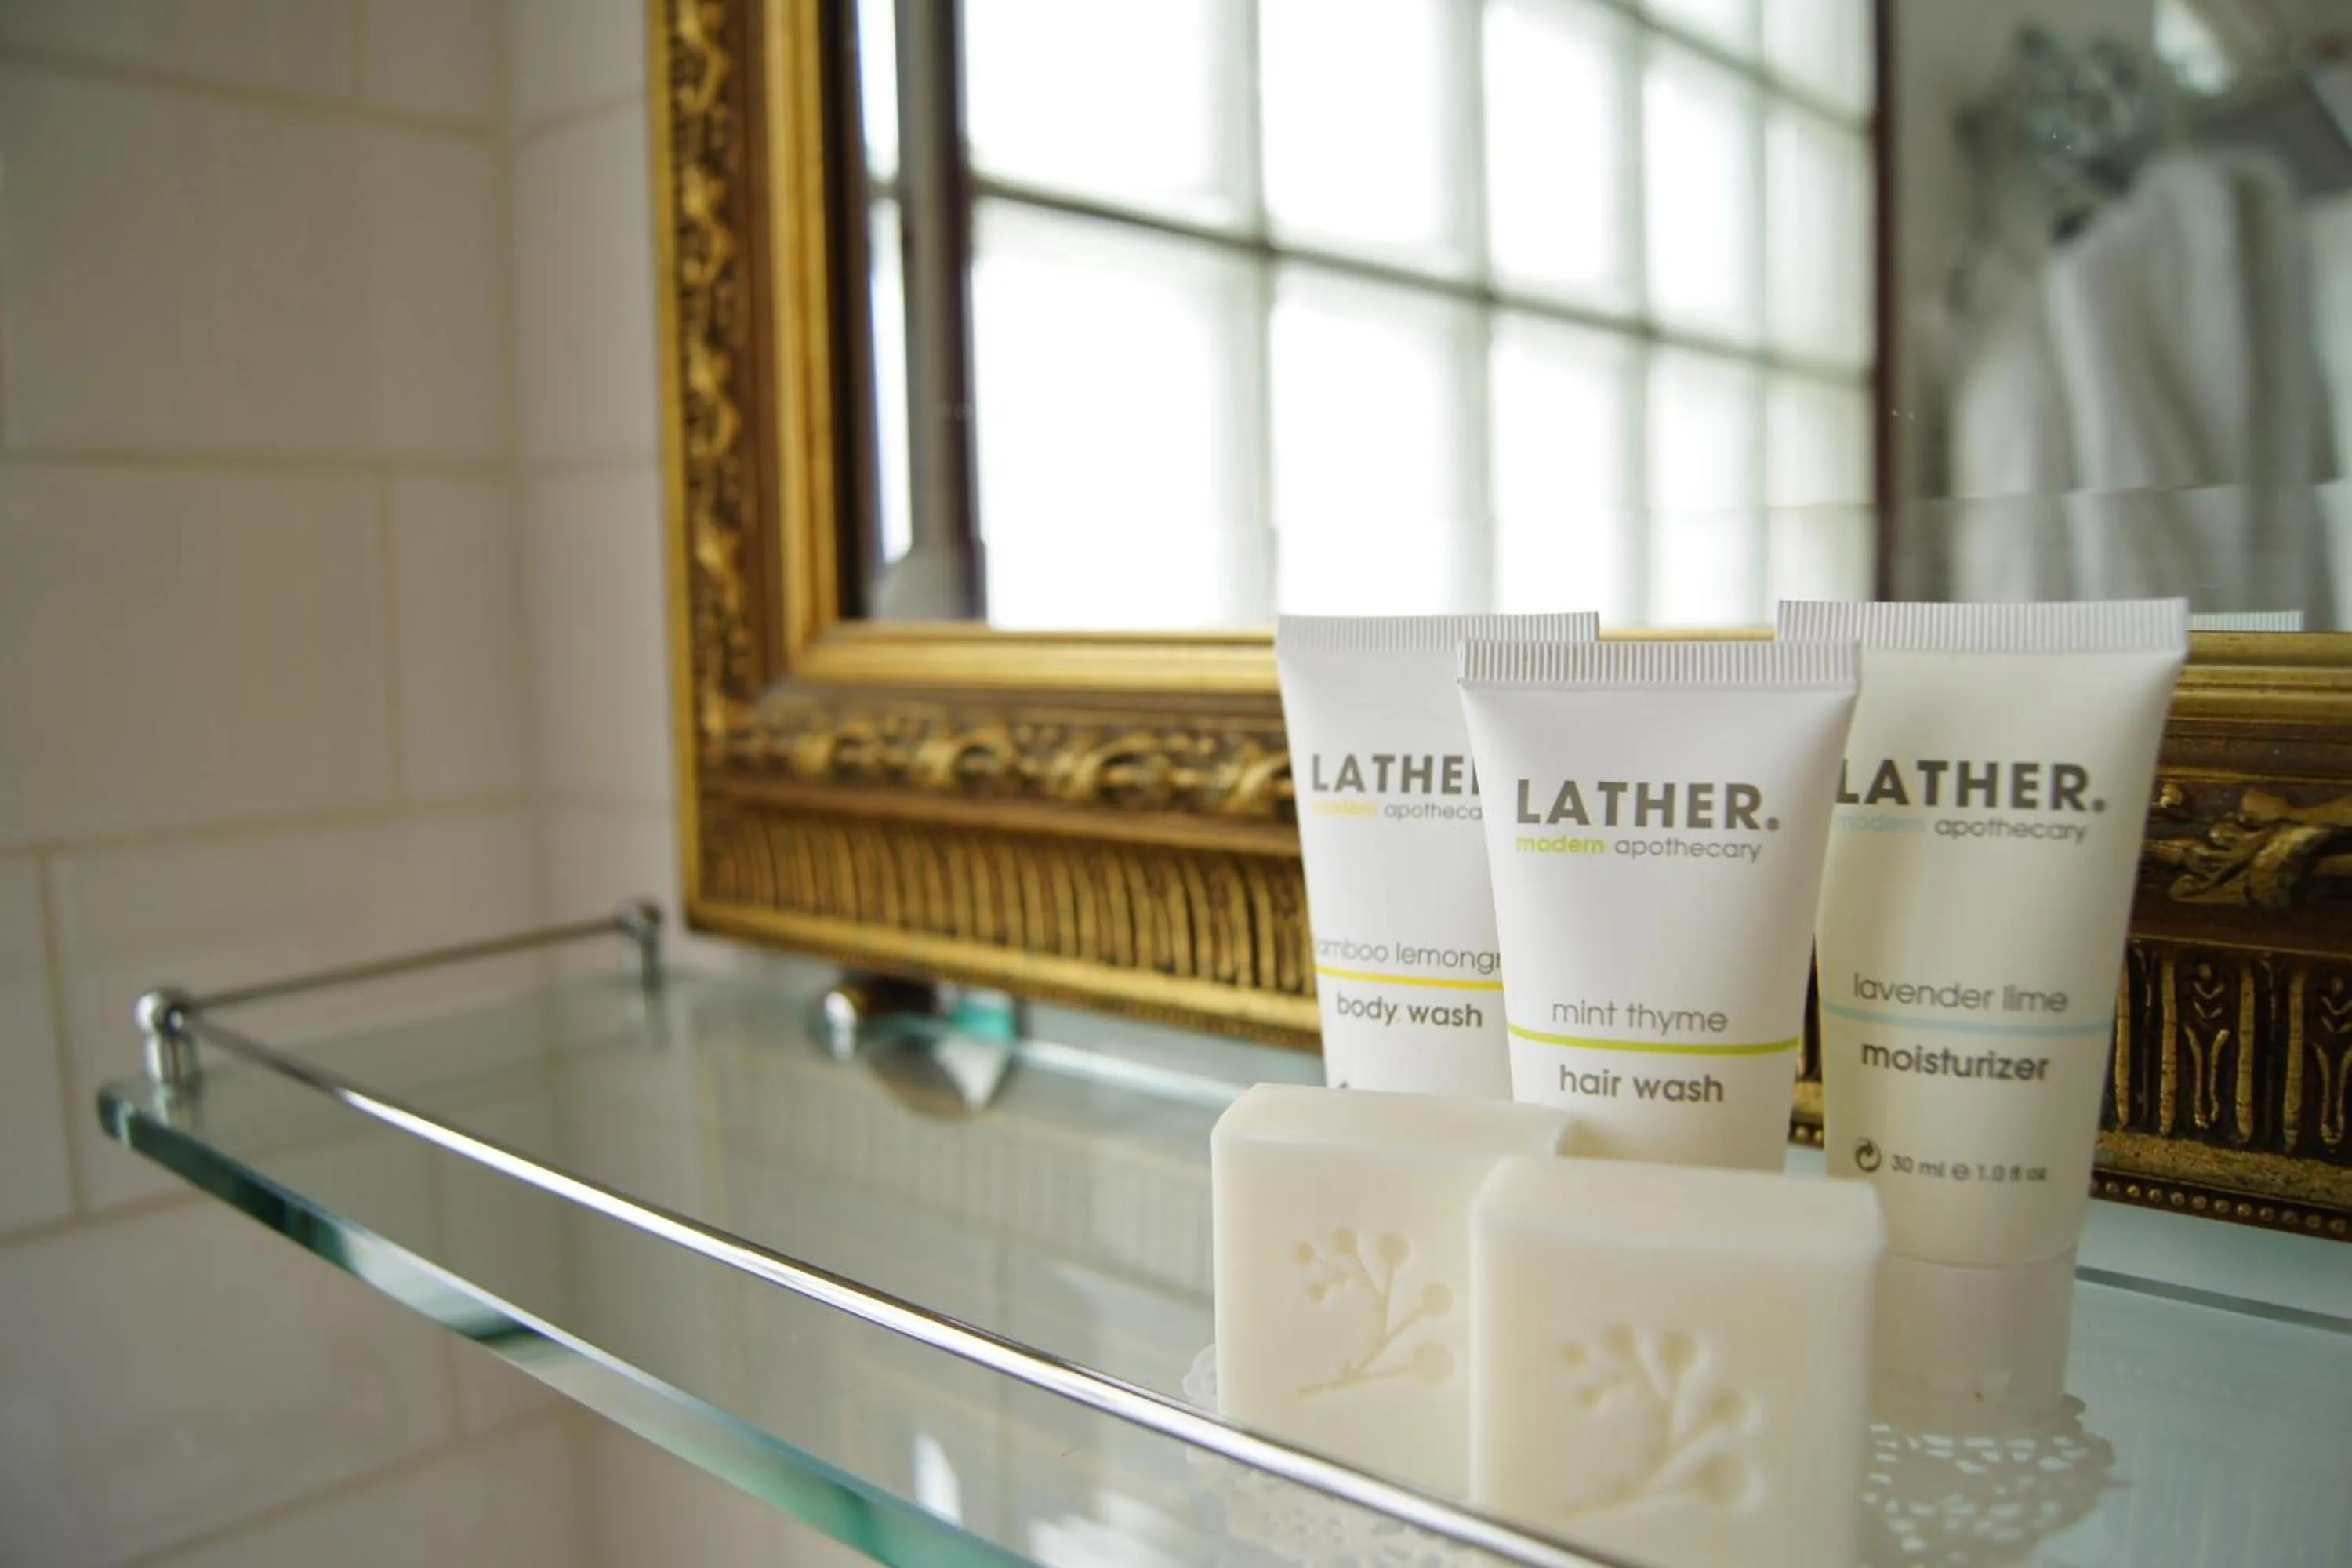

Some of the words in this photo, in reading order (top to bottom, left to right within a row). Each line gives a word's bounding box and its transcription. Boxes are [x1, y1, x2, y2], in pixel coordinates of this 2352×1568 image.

[1835, 758, 2106, 813] LATHER.
[1516, 779, 1780, 832] LATHER.
[1516, 834, 1605, 854] modern
[1614, 837, 1762, 862] apothecary
[1934, 818, 2088, 844] apothecary
[1337, 991, 1397, 1026] body
[1408, 1004, 1483, 1028] wash
[1853, 972, 1994, 1010] lavender
[2002, 985, 2069, 1013] lime
[1552, 1000, 1617, 1026] mint
[1626, 1003, 1728, 1036] thyme
[1861, 1041, 2050, 1080] moisturizer
[1559, 1065, 1621, 1097] hair
[1632, 1074, 1723, 1102] wash
[1891, 1154, 1914, 1174] 30
[1918, 1160, 1945, 1178] ml
